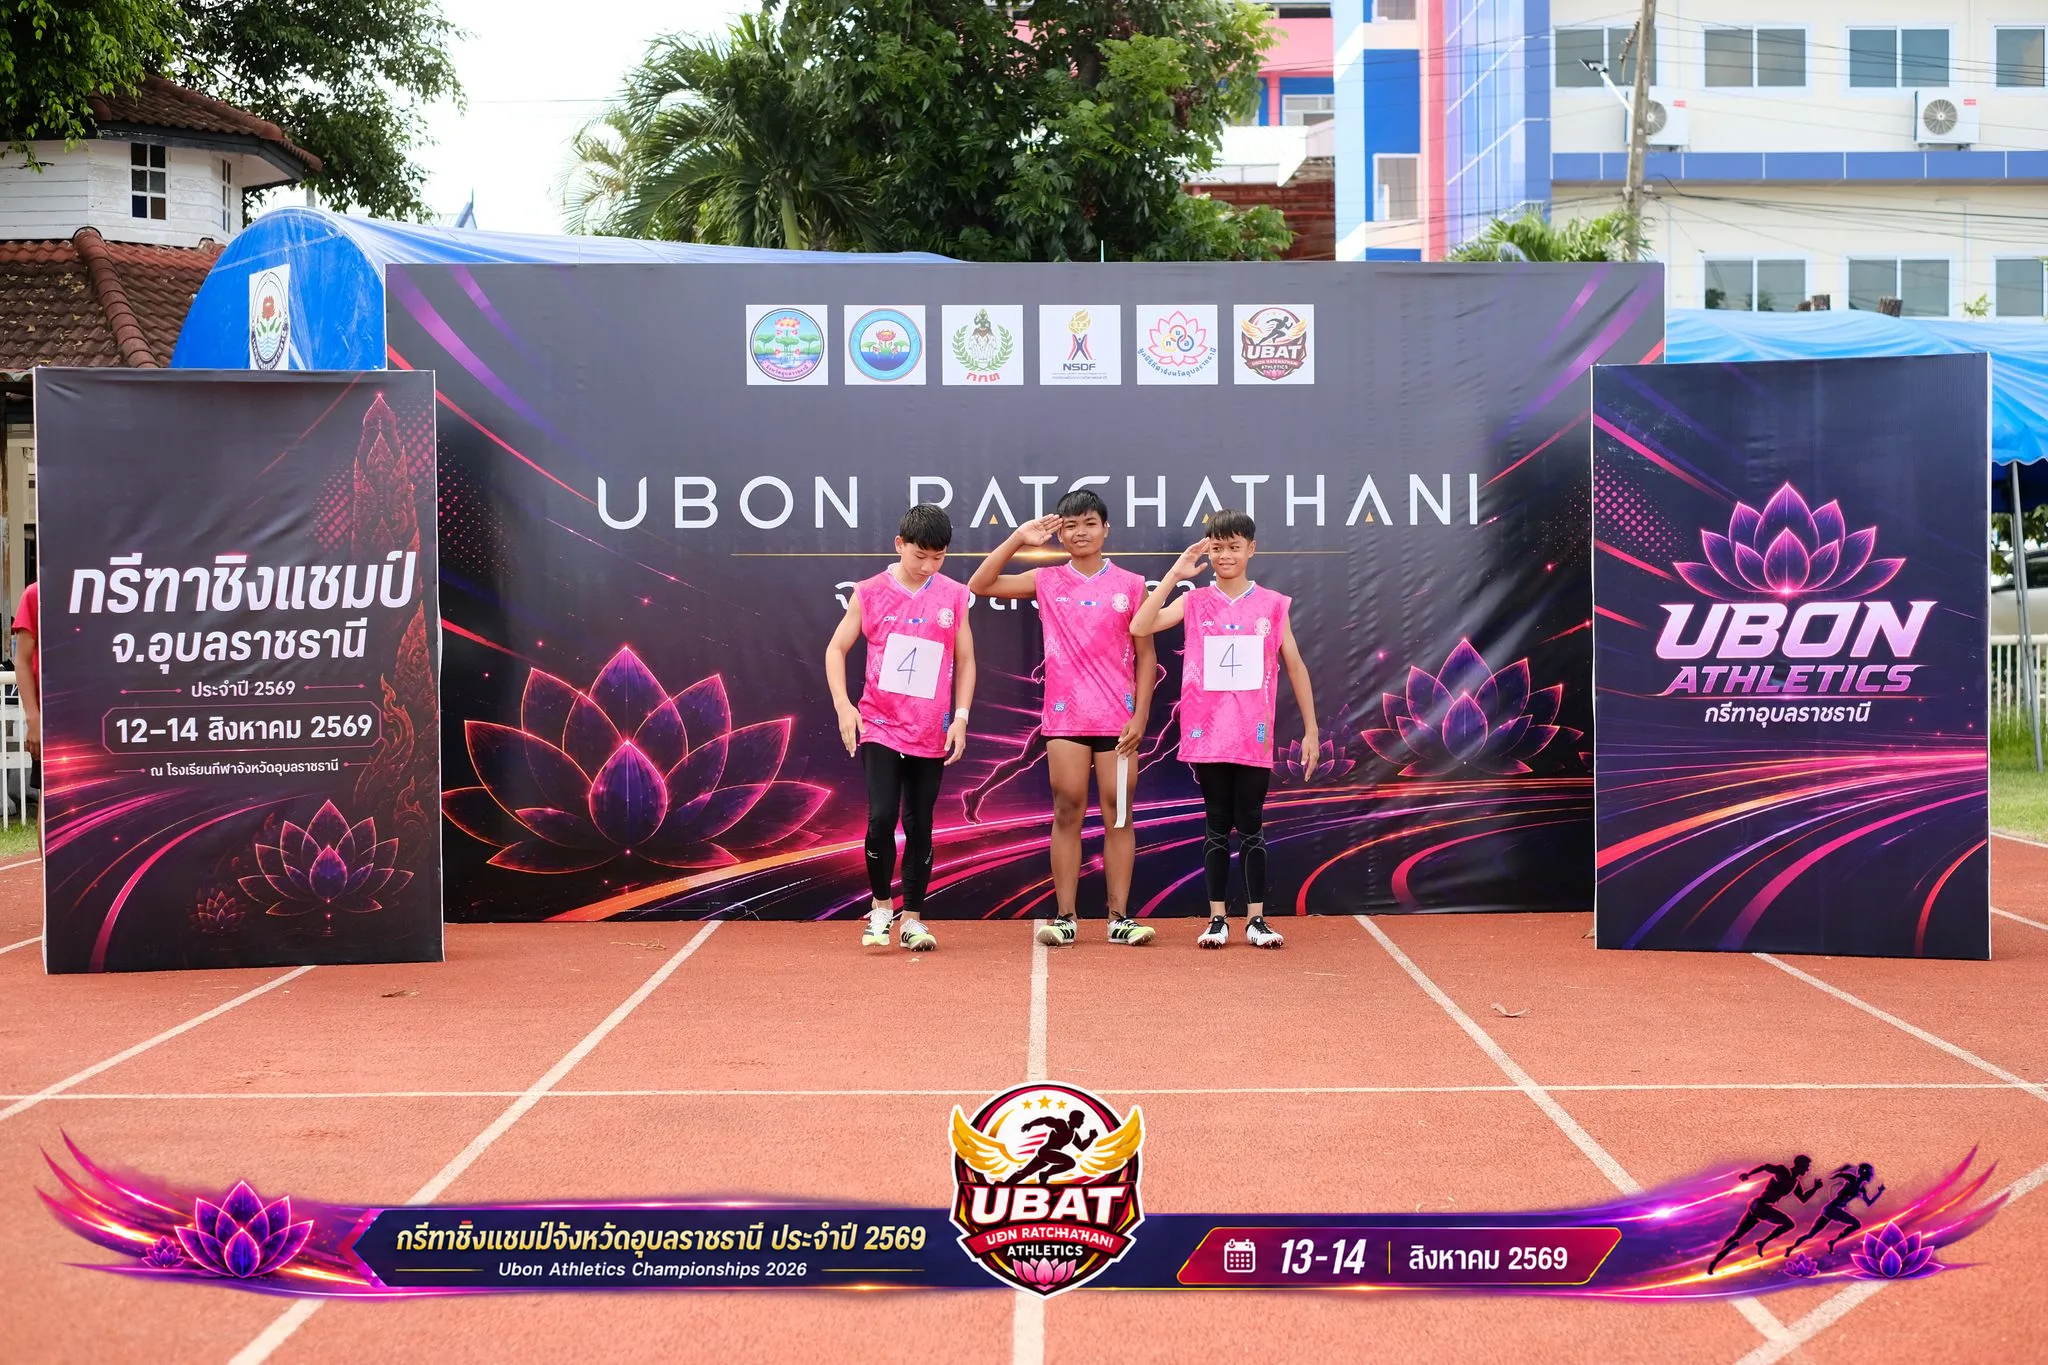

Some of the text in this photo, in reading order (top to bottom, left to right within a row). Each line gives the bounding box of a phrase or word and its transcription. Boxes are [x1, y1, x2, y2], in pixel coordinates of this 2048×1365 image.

[1247, 345, 1302, 359] UBAT
[1063, 363, 1096, 371] NSDF
[598, 476, 858, 530] UBON
[69, 551, 416, 614] กรีฑาชิงแชมป์
[1656, 601, 1938, 659] UBON
[112, 618, 367, 675] จ.อุบลราชธานี
[1219, 643, 1242, 678] 4
[897, 647, 917, 685] 4
[1660, 665, 1926, 694] ATHLETICS
[191, 680, 296, 698] ประจำปี 2569
[208, 717, 302, 743] สิงหาคม
[310, 715, 373, 739] 2569
[1704, 701, 1871, 728] กรีฑาอุบลราชธานี
[150, 759, 339, 777] ณ โรงเรียนกีฬาจังหวัดอุบลราชธานี
